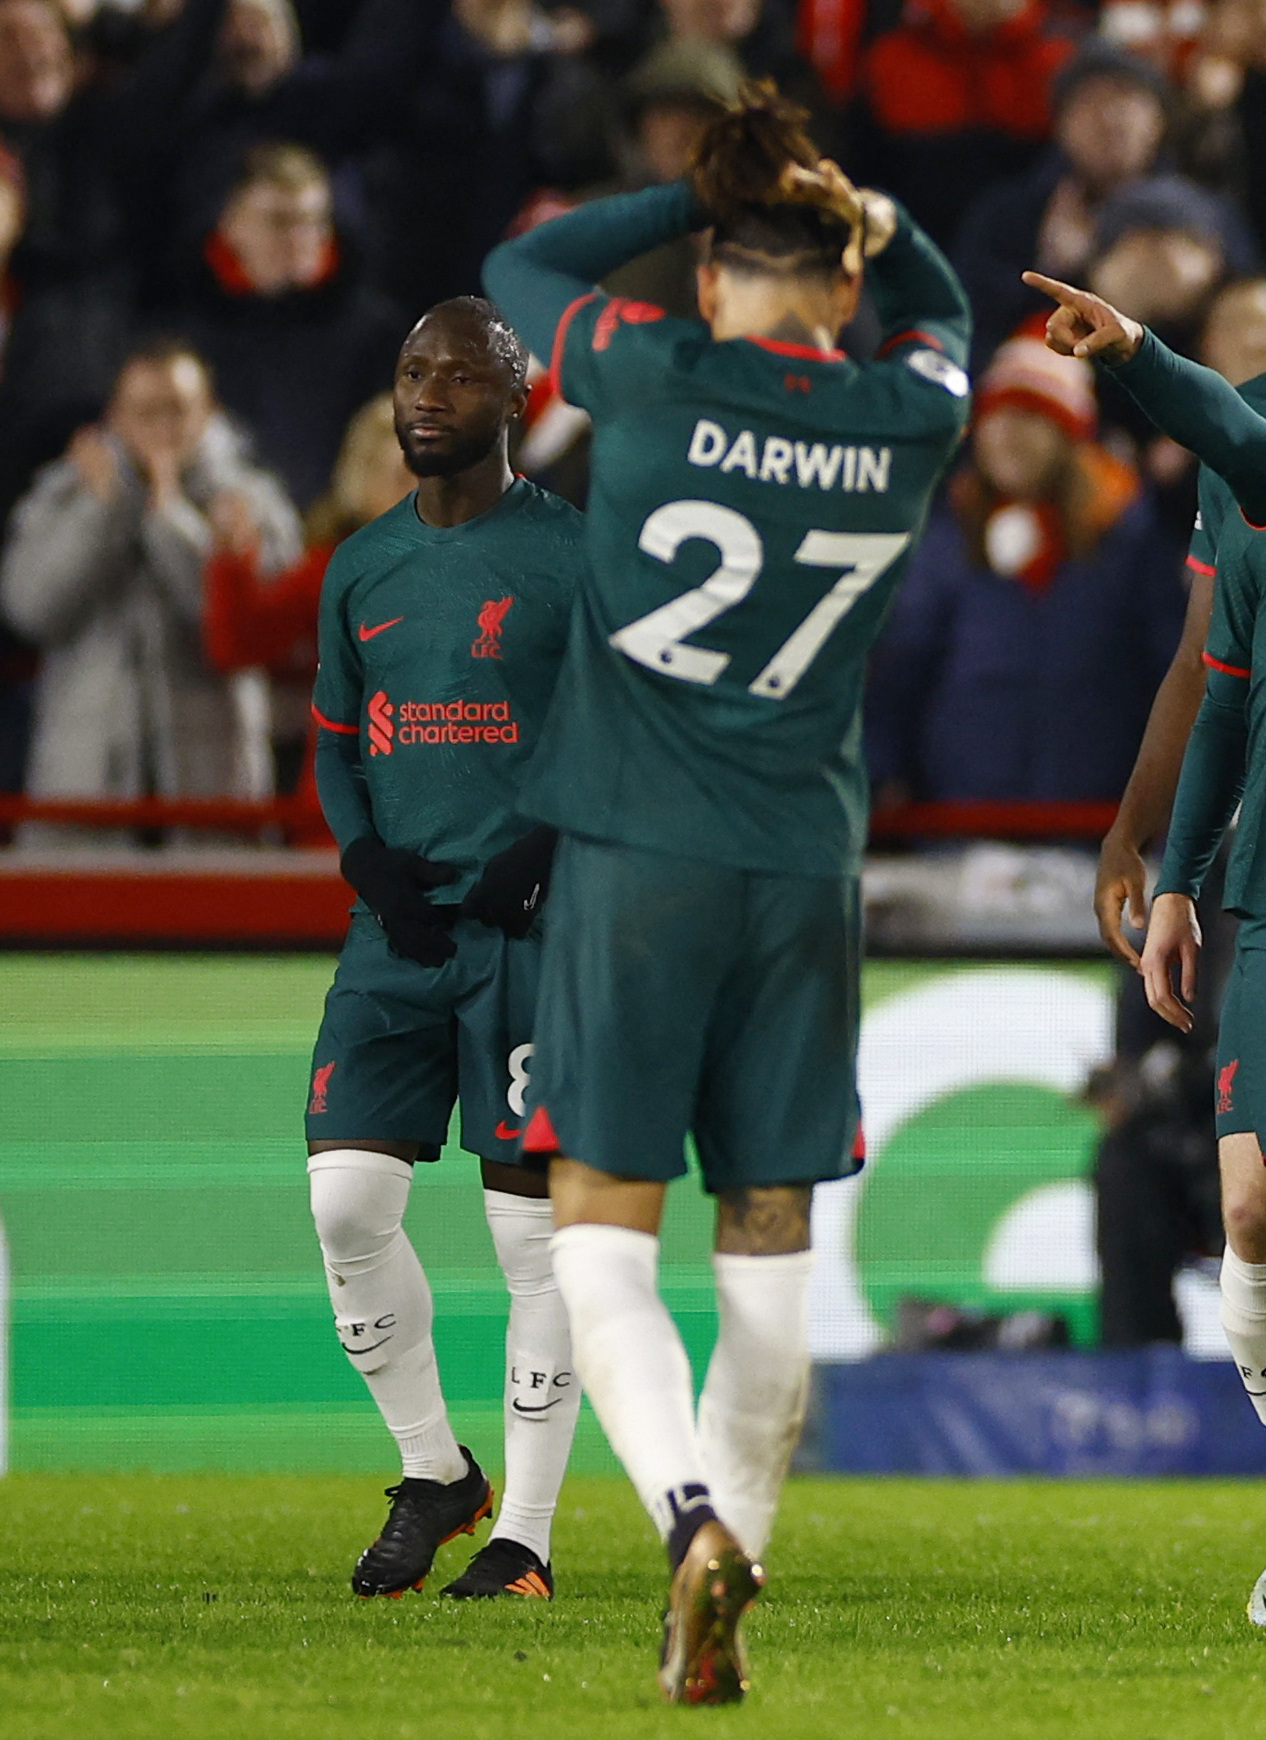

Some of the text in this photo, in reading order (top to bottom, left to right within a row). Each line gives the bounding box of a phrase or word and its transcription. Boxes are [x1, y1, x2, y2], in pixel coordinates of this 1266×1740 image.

[688, 419, 892, 493] DARWIN
[609, 499, 910, 700] 27
[398, 722, 518, 744] chartered
[399, 699, 510, 722] standard
